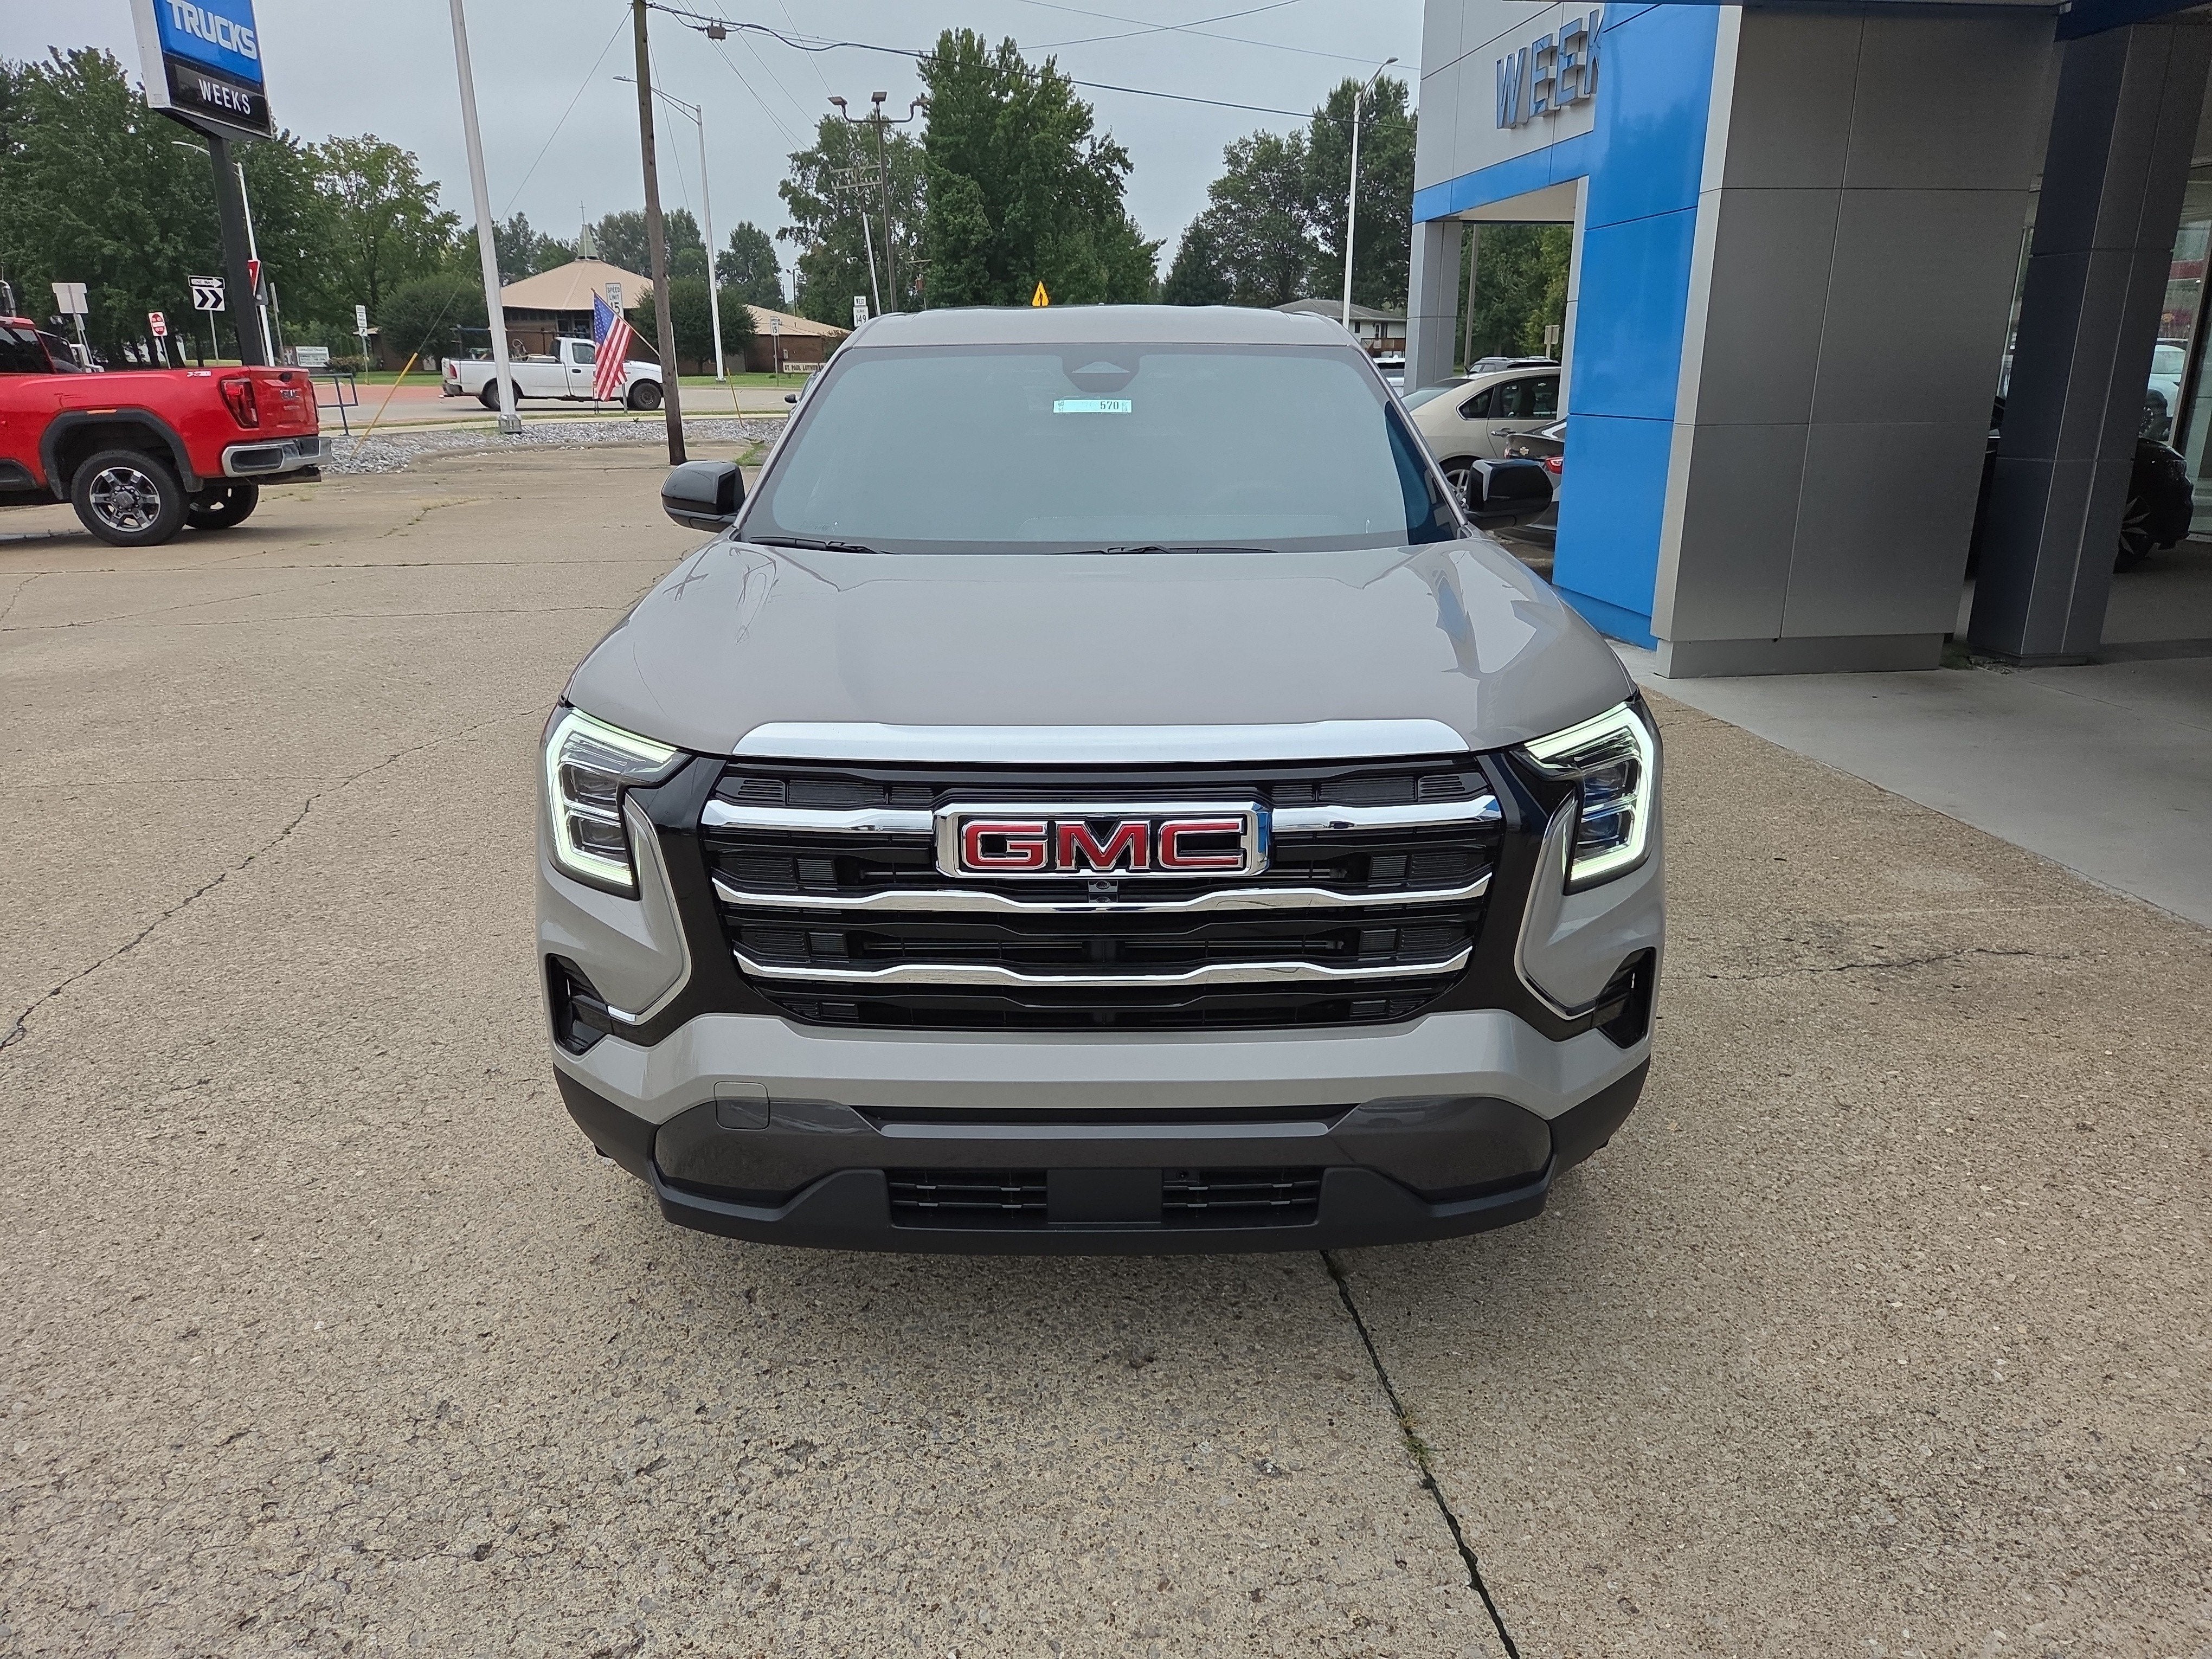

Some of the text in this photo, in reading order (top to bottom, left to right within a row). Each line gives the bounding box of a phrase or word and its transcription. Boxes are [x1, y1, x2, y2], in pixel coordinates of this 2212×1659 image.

[166, 0, 258, 60] TRUCKS
[198, 78, 250, 115] WEEKS
[856, 314, 866, 325] 149
[1100, 401, 1119, 410] 570
[961, 818, 1244, 871] GMC
